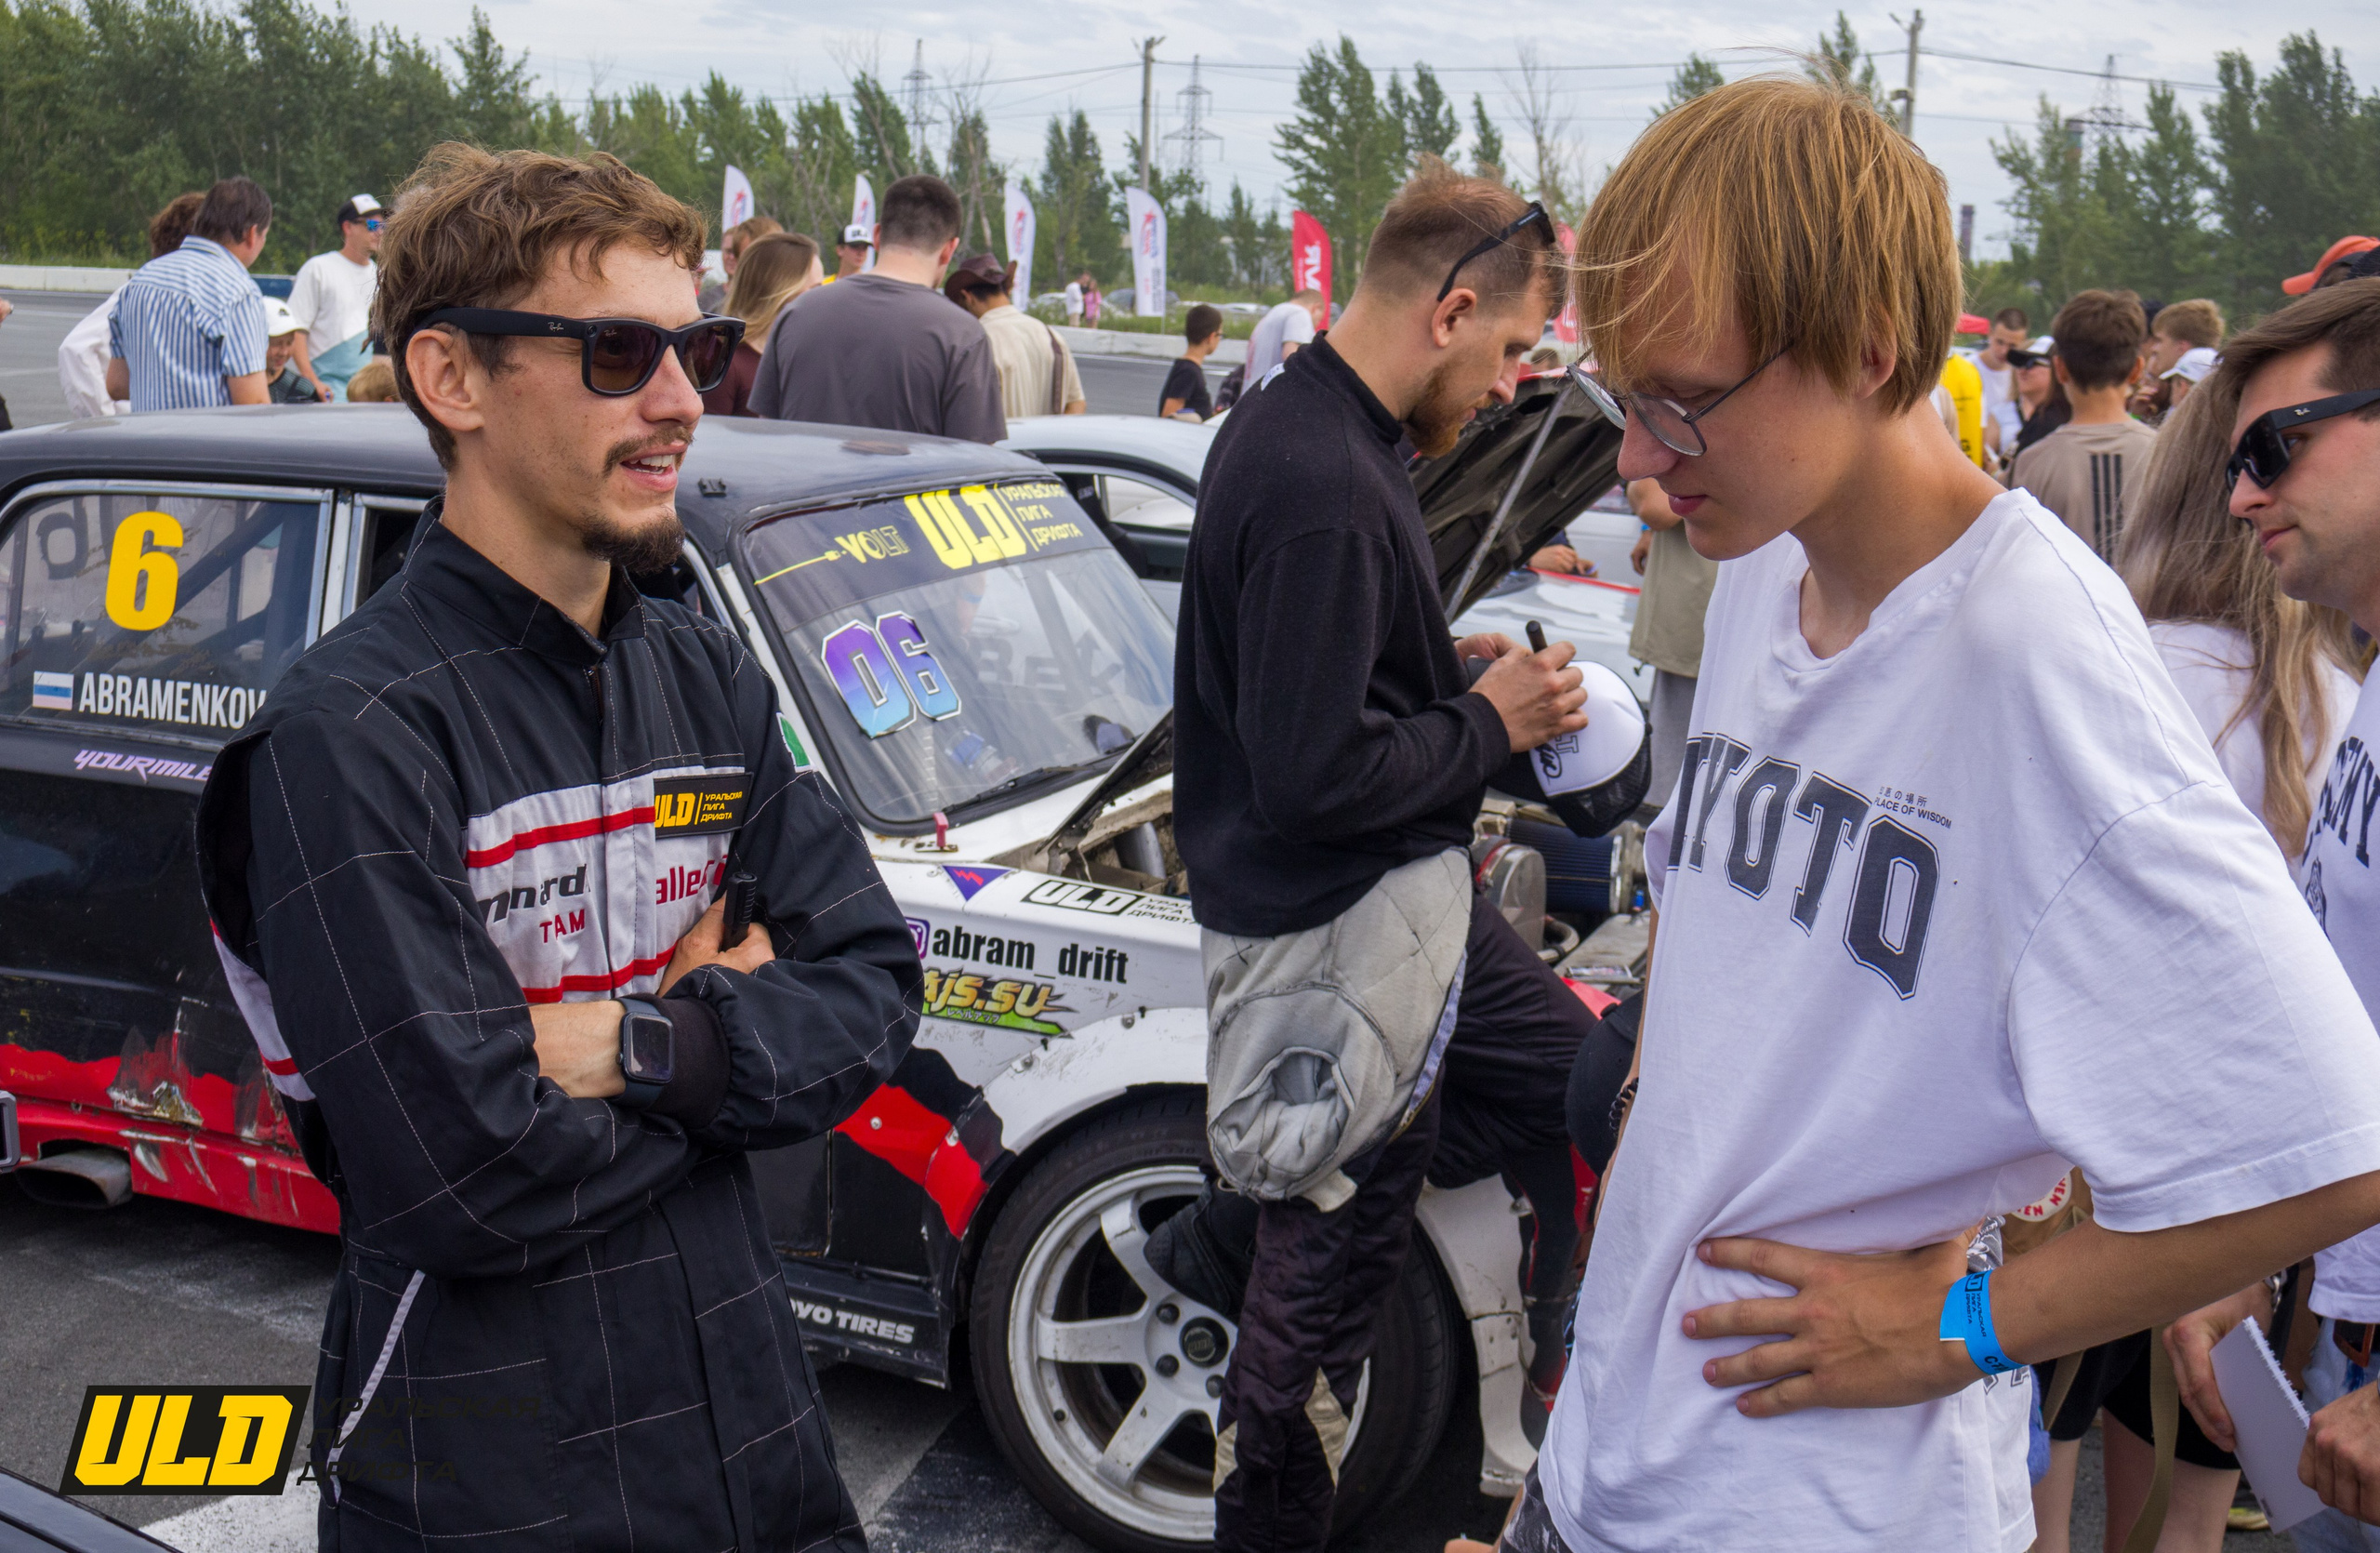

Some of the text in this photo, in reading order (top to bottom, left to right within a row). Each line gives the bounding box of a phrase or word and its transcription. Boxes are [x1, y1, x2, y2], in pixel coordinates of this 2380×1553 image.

[905, 484, 1026, 570] ULD
[1015, 504, 1053, 522] ЛИГА
[834, 524, 910, 564] VOLT
[105, 511, 183, 631] 6
[821, 610, 961, 739] 06
[78, 671, 267, 729] ABRAMENKOV
[700, 812, 733, 823] ДРИФТА
[703, 803, 725, 811] ЛИГА
[1901, 804, 1915, 815] OF
[1918, 808, 1951, 829] WISDOM
[1027, 881, 1137, 914] ULD
[932, 925, 1129, 984] abram_drift
[836, 1310, 915, 1344] TIRES
